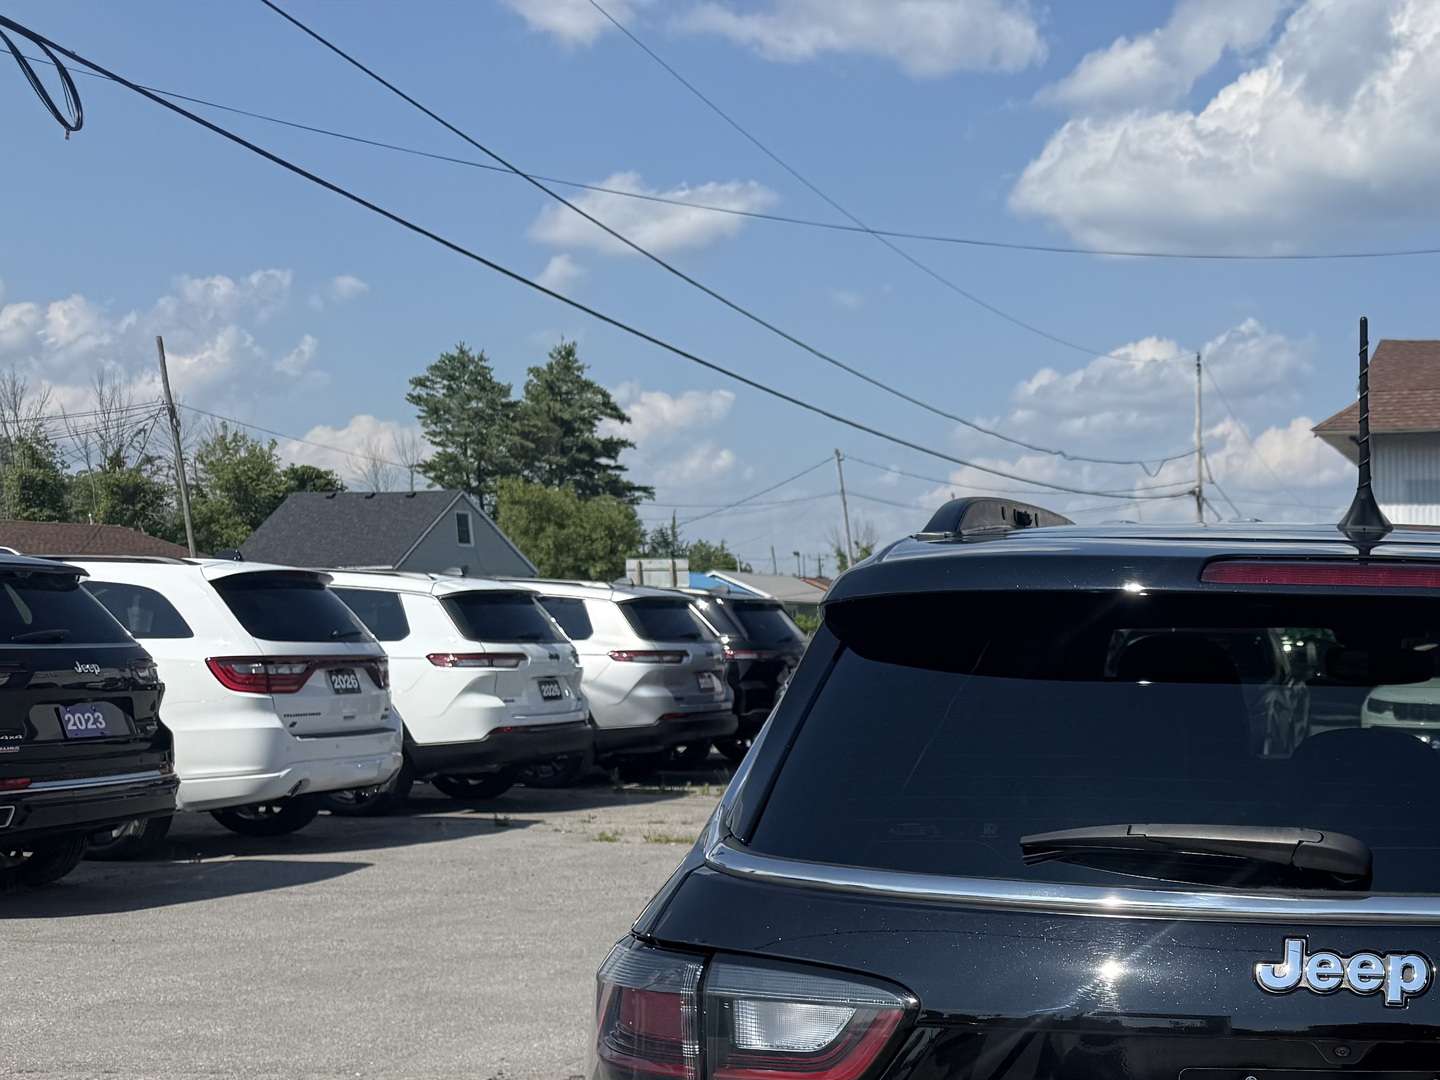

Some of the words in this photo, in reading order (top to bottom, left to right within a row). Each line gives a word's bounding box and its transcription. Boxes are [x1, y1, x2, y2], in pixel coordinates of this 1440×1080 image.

[73, 660, 101, 675] Jeep
[331, 674, 359, 689] 2026
[64, 711, 107, 730] 2023
[1255, 934, 1436, 1009] Jeep
